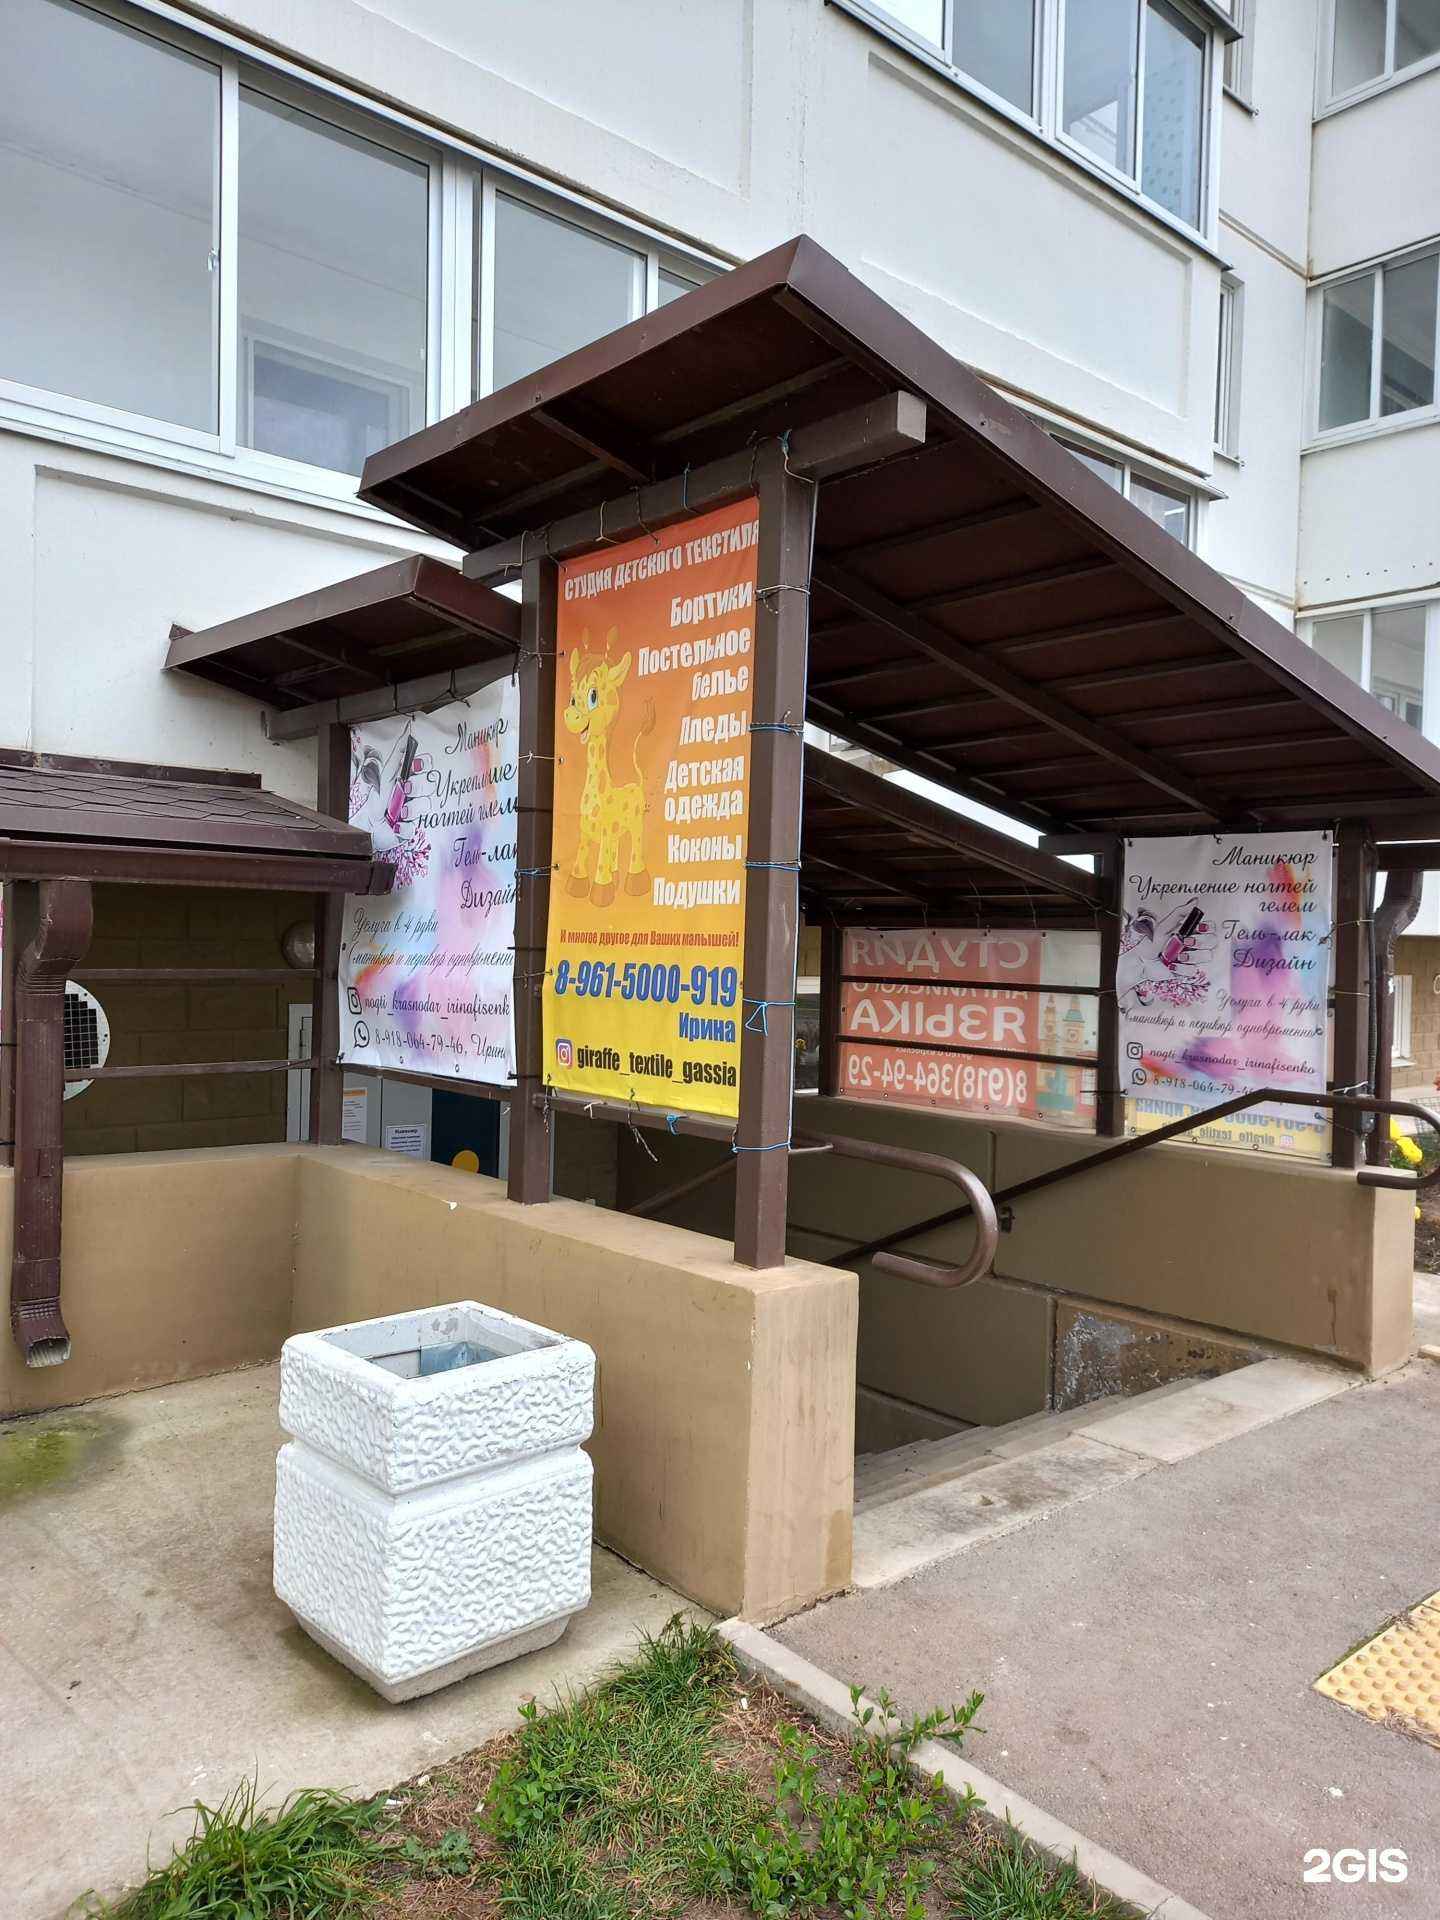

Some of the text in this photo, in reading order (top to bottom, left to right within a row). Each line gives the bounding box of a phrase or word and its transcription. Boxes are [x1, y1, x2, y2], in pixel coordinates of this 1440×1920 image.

[565, 519, 760, 600] СТУДИЯ ДЕТСКОГО ТЕКСТИЛЯ
[670, 581, 753, 628] Бортики
[638, 627, 751, 677] Постельное
[692, 665, 749, 701] белье
[445, 718, 508, 754] Маникюр
[680, 710, 748, 746] Пледы
[664, 756, 744, 794] Детская
[418, 803, 475, 829] ногтей
[664, 789, 743, 824] одежда
[668, 834, 742, 865] Коконы
[1212, 846, 1318, 871] Маникюр
[653, 877, 740, 910] Подушки
[1129, 874, 1318, 900] Укрепление ногтей
[1259, 900, 1318, 914] гелем
[568, 930, 598, 945] многое
[599, 930, 630, 947] другое
[630, 931, 649, 947] для
[650, 930, 681, 946] Ваших
[682, 931, 739, 947] малышей!
[1222, 919, 1317, 942] Гель-лак
[1233, 947, 1318, 976] Дизайн
[555, 959, 738, 1007] 8-961-5000-919
[364, 990, 511, 1022] nogti_krasnodar_irinafisenk
[1216, 988, 1263, 1014] Услуги
[1288, 994, 1320, 1016] руки
[679, 1012, 736, 1043] Ирина
[1189, 1016, 1233, 1036] педикюр
[577, 1045, 737, 1087] giraffe_textile_gassia
